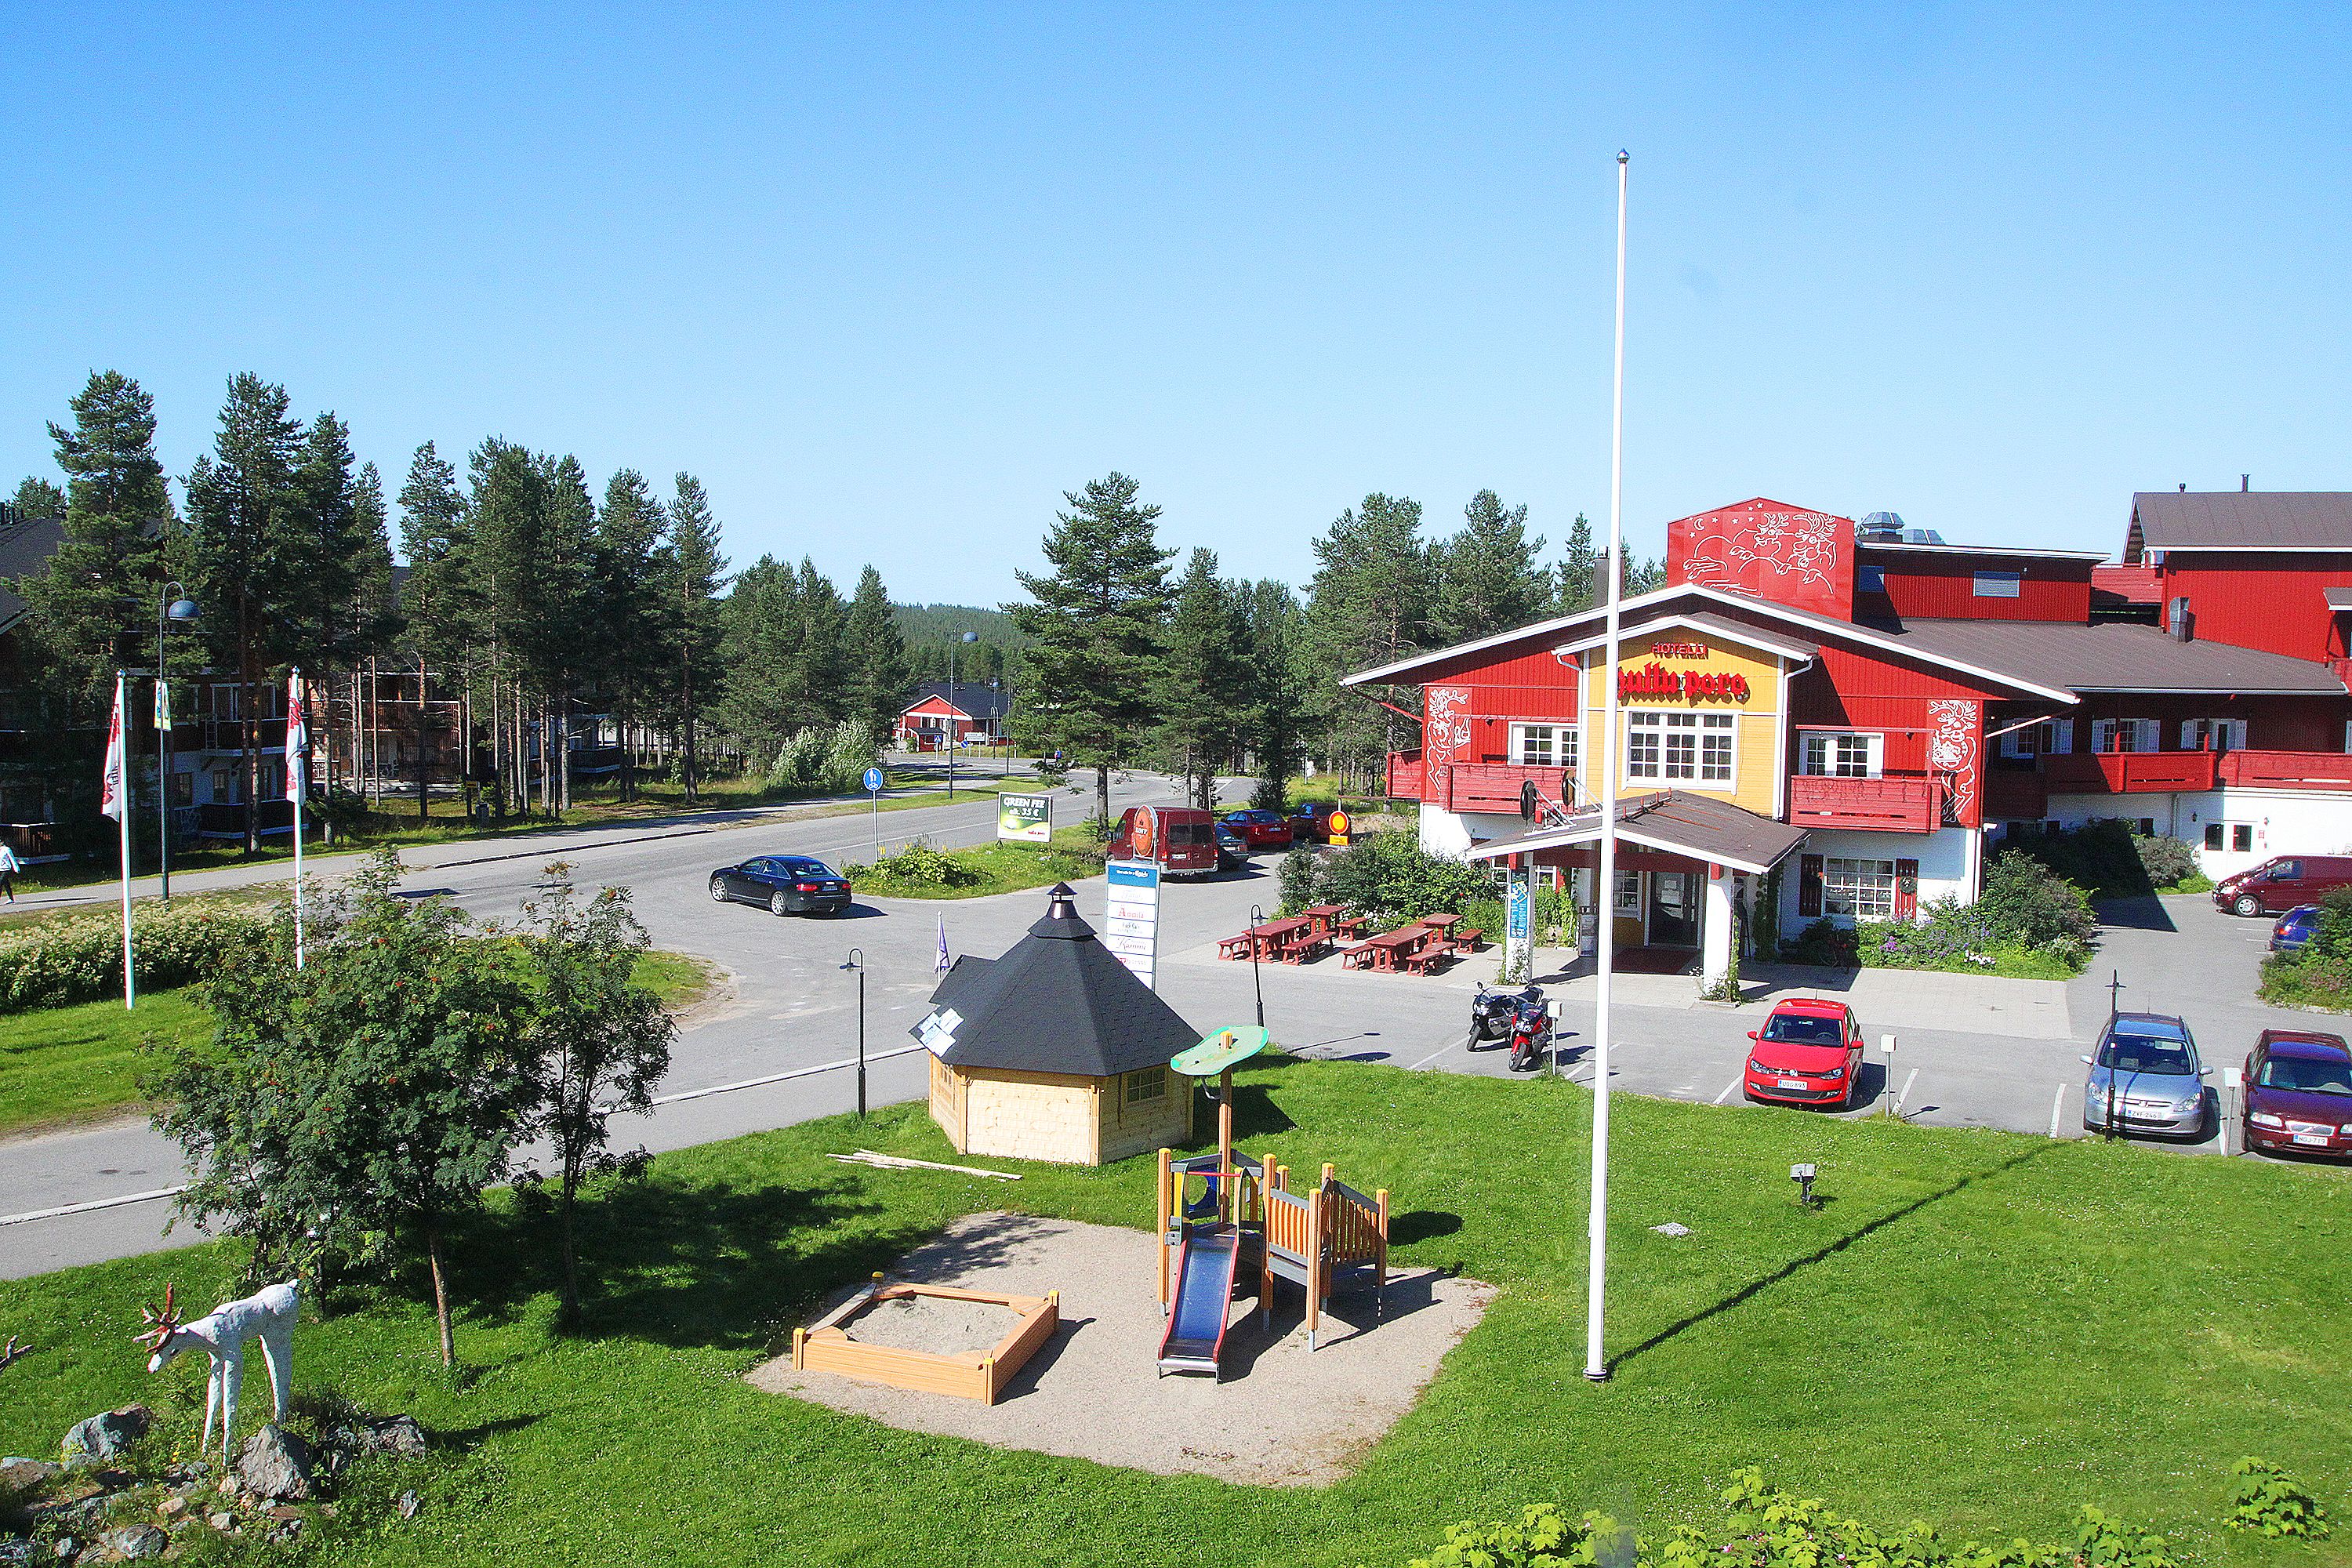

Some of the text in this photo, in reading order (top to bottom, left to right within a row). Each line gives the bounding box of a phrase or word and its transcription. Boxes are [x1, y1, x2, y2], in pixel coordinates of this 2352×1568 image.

[1651, 642, 1708, 654] HOTELLI
[1617, 662, 1746, 698] ullu poro
[1003, 797, 1046, 809] GREEN FEE
[1033, 808, 1040, 817] €
